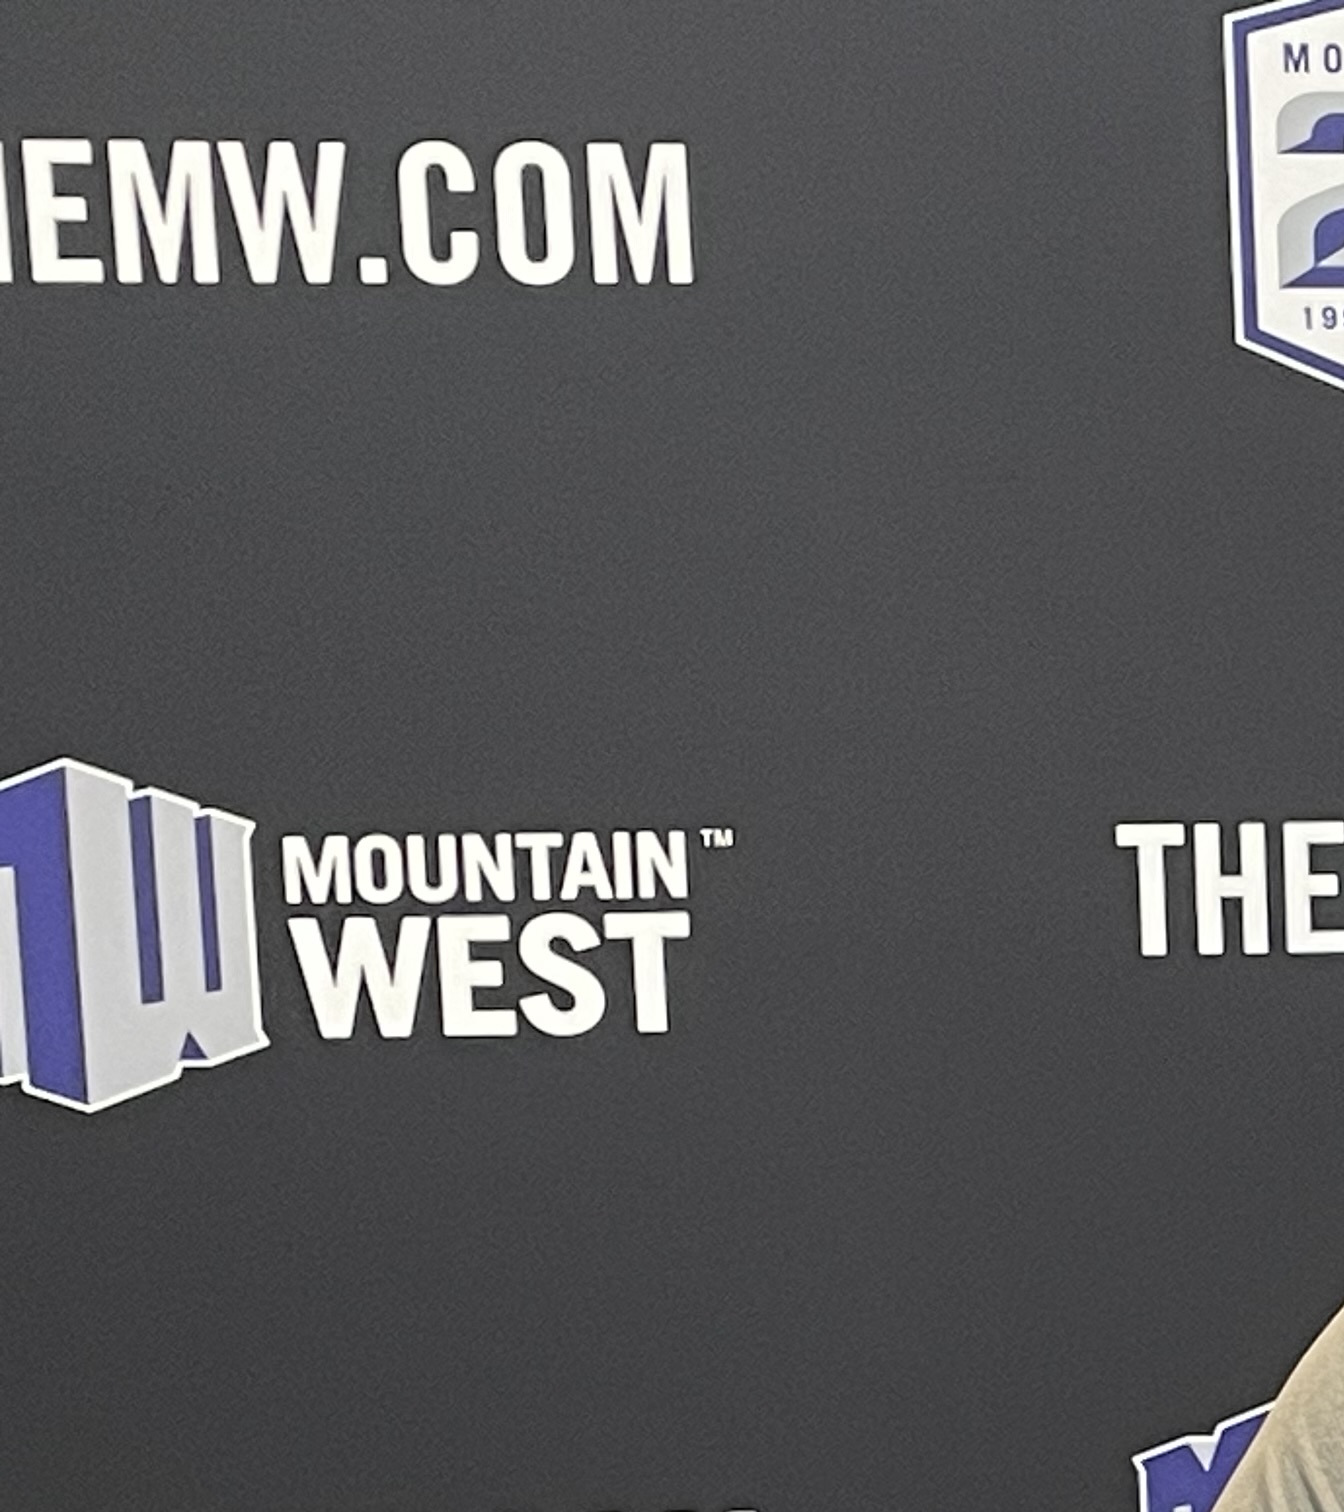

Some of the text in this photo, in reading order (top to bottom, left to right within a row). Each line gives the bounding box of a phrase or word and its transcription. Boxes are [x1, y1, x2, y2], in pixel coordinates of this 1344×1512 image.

[0, 138, 695, 286] EMW.COM
[281, 830, 690, 905] MOUNTAIN
[287, 911, 692, 1039] WEST
